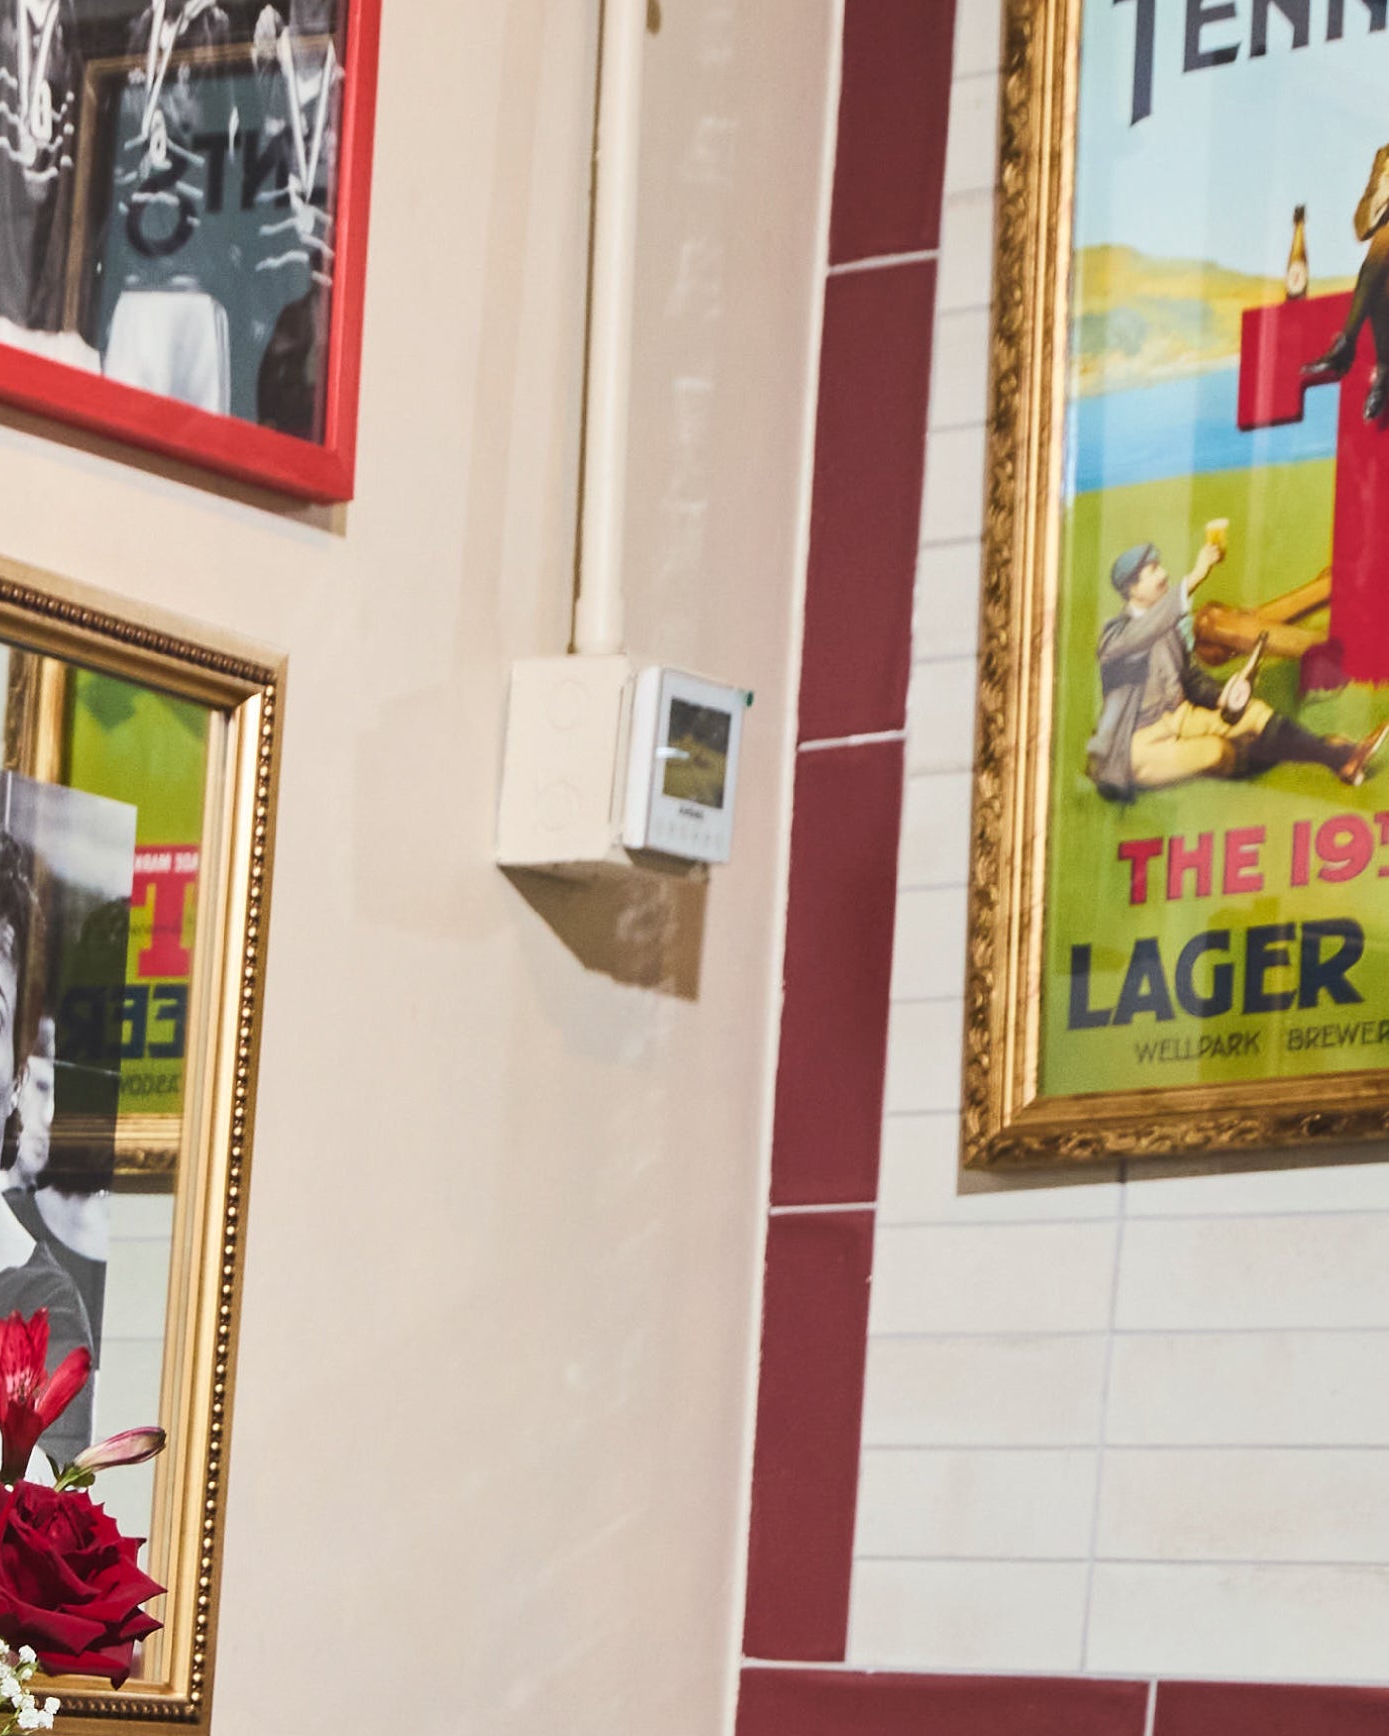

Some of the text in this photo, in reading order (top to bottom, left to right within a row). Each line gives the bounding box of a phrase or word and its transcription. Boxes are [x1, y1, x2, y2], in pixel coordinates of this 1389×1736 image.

[1118, 825, 1266, 906] THE
[1067, 917, 1365, 1031] LAGER
[1134, 1030, 1262, 1064] WELLPARK
